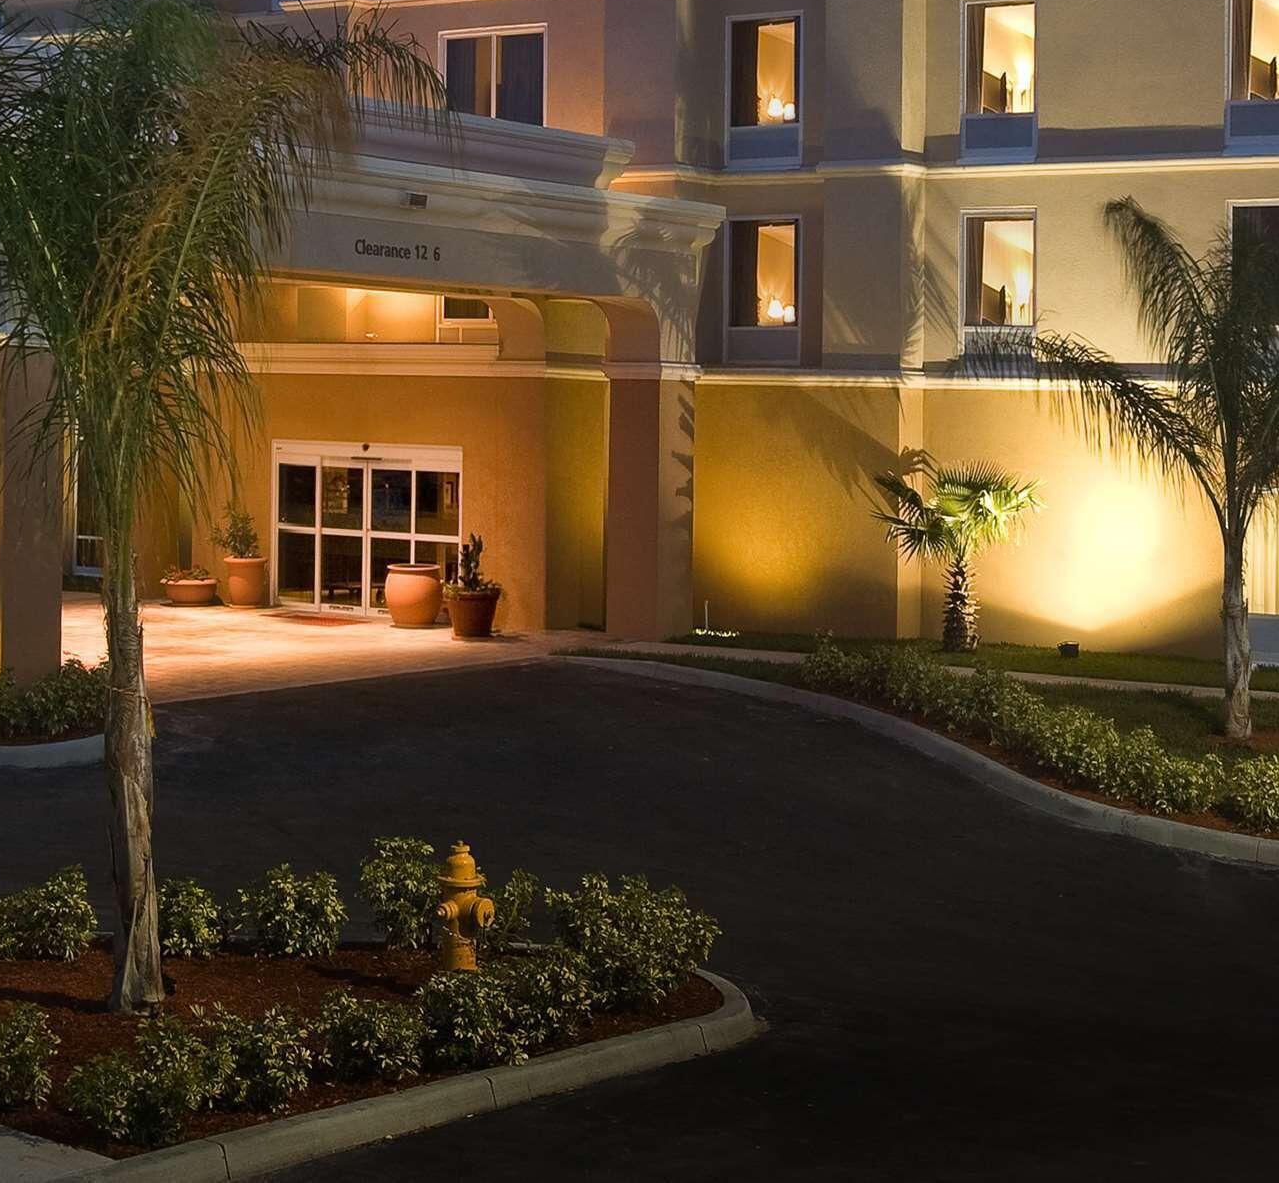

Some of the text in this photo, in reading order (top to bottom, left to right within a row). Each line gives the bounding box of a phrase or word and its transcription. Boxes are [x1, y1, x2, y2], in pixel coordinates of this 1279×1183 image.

[354, 238, 441, 262] Clearance 12 6
